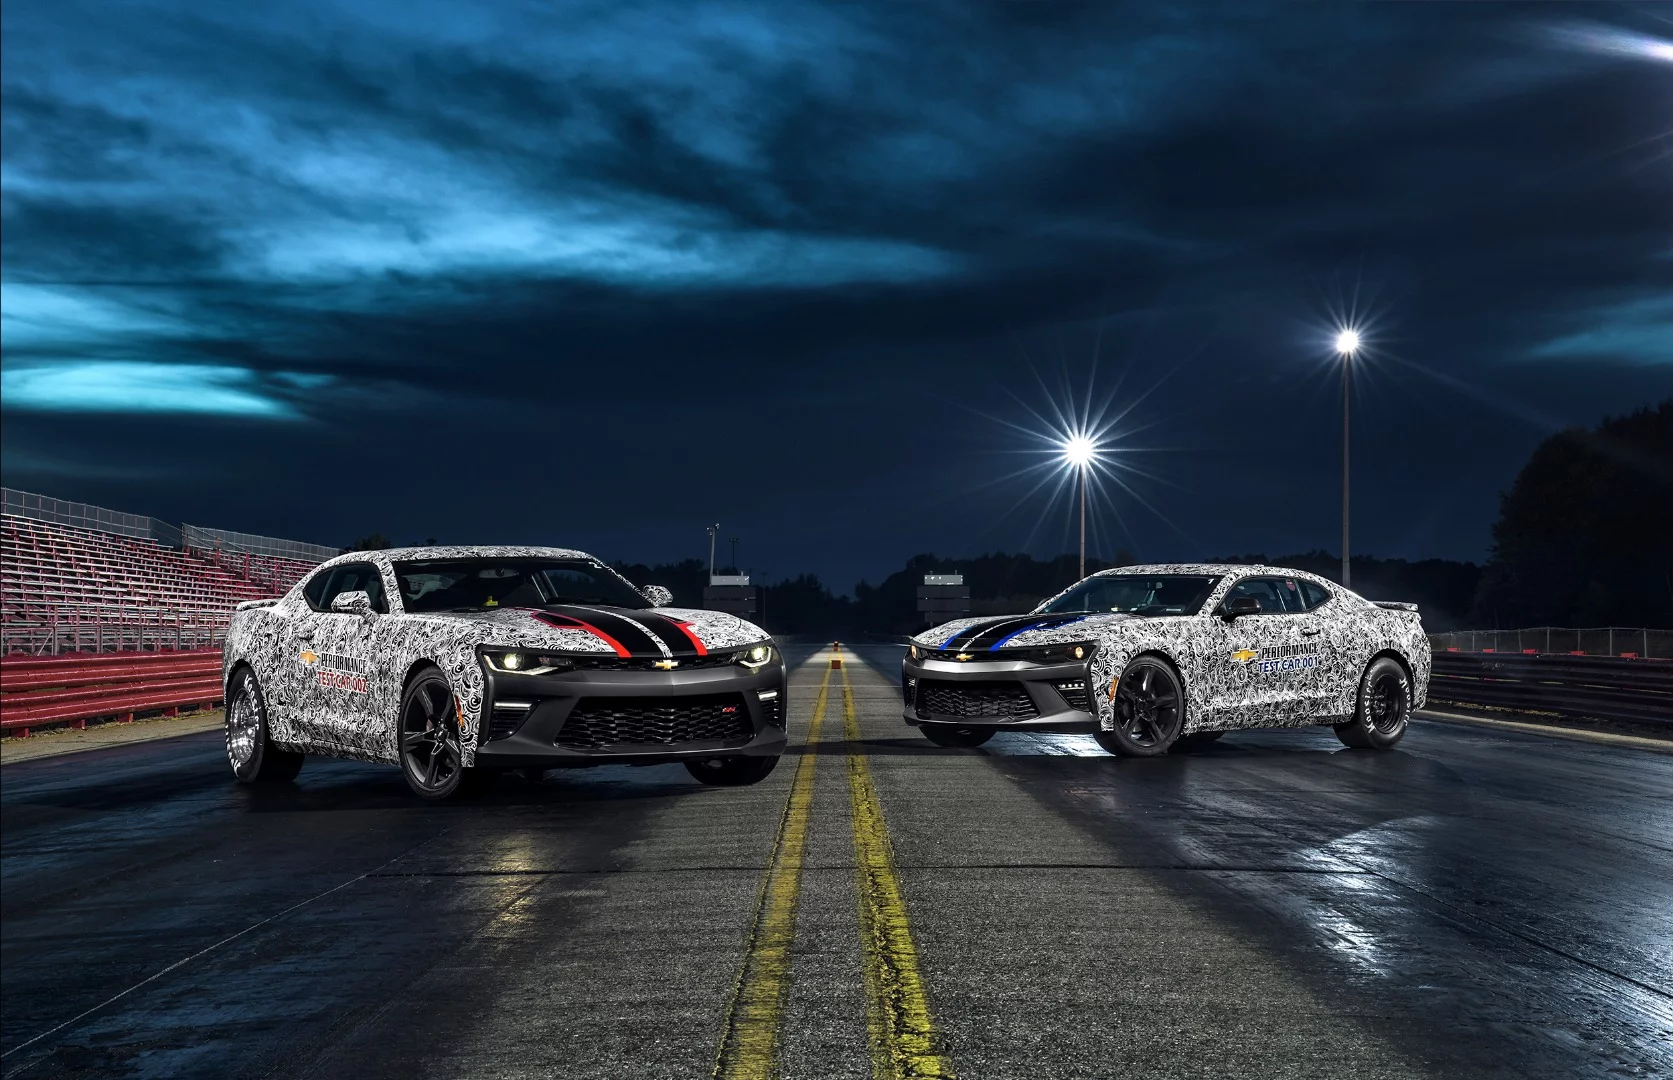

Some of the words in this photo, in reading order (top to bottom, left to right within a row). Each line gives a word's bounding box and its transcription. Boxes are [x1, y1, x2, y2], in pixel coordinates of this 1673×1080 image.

[1261, 642, 1318, 659] PERFORMANCE
[321, 652, 366, 674] PERFORMANCE
[1258, 660, 1280, 673] TEST
[1281, 658, 1300, 670] CAR
[1302, 656, 1318, 668] 001
[317, 671, 334, 687] TEST
[335, 674, 351, 689] CAR
[352, 677, 367, 692] 002
